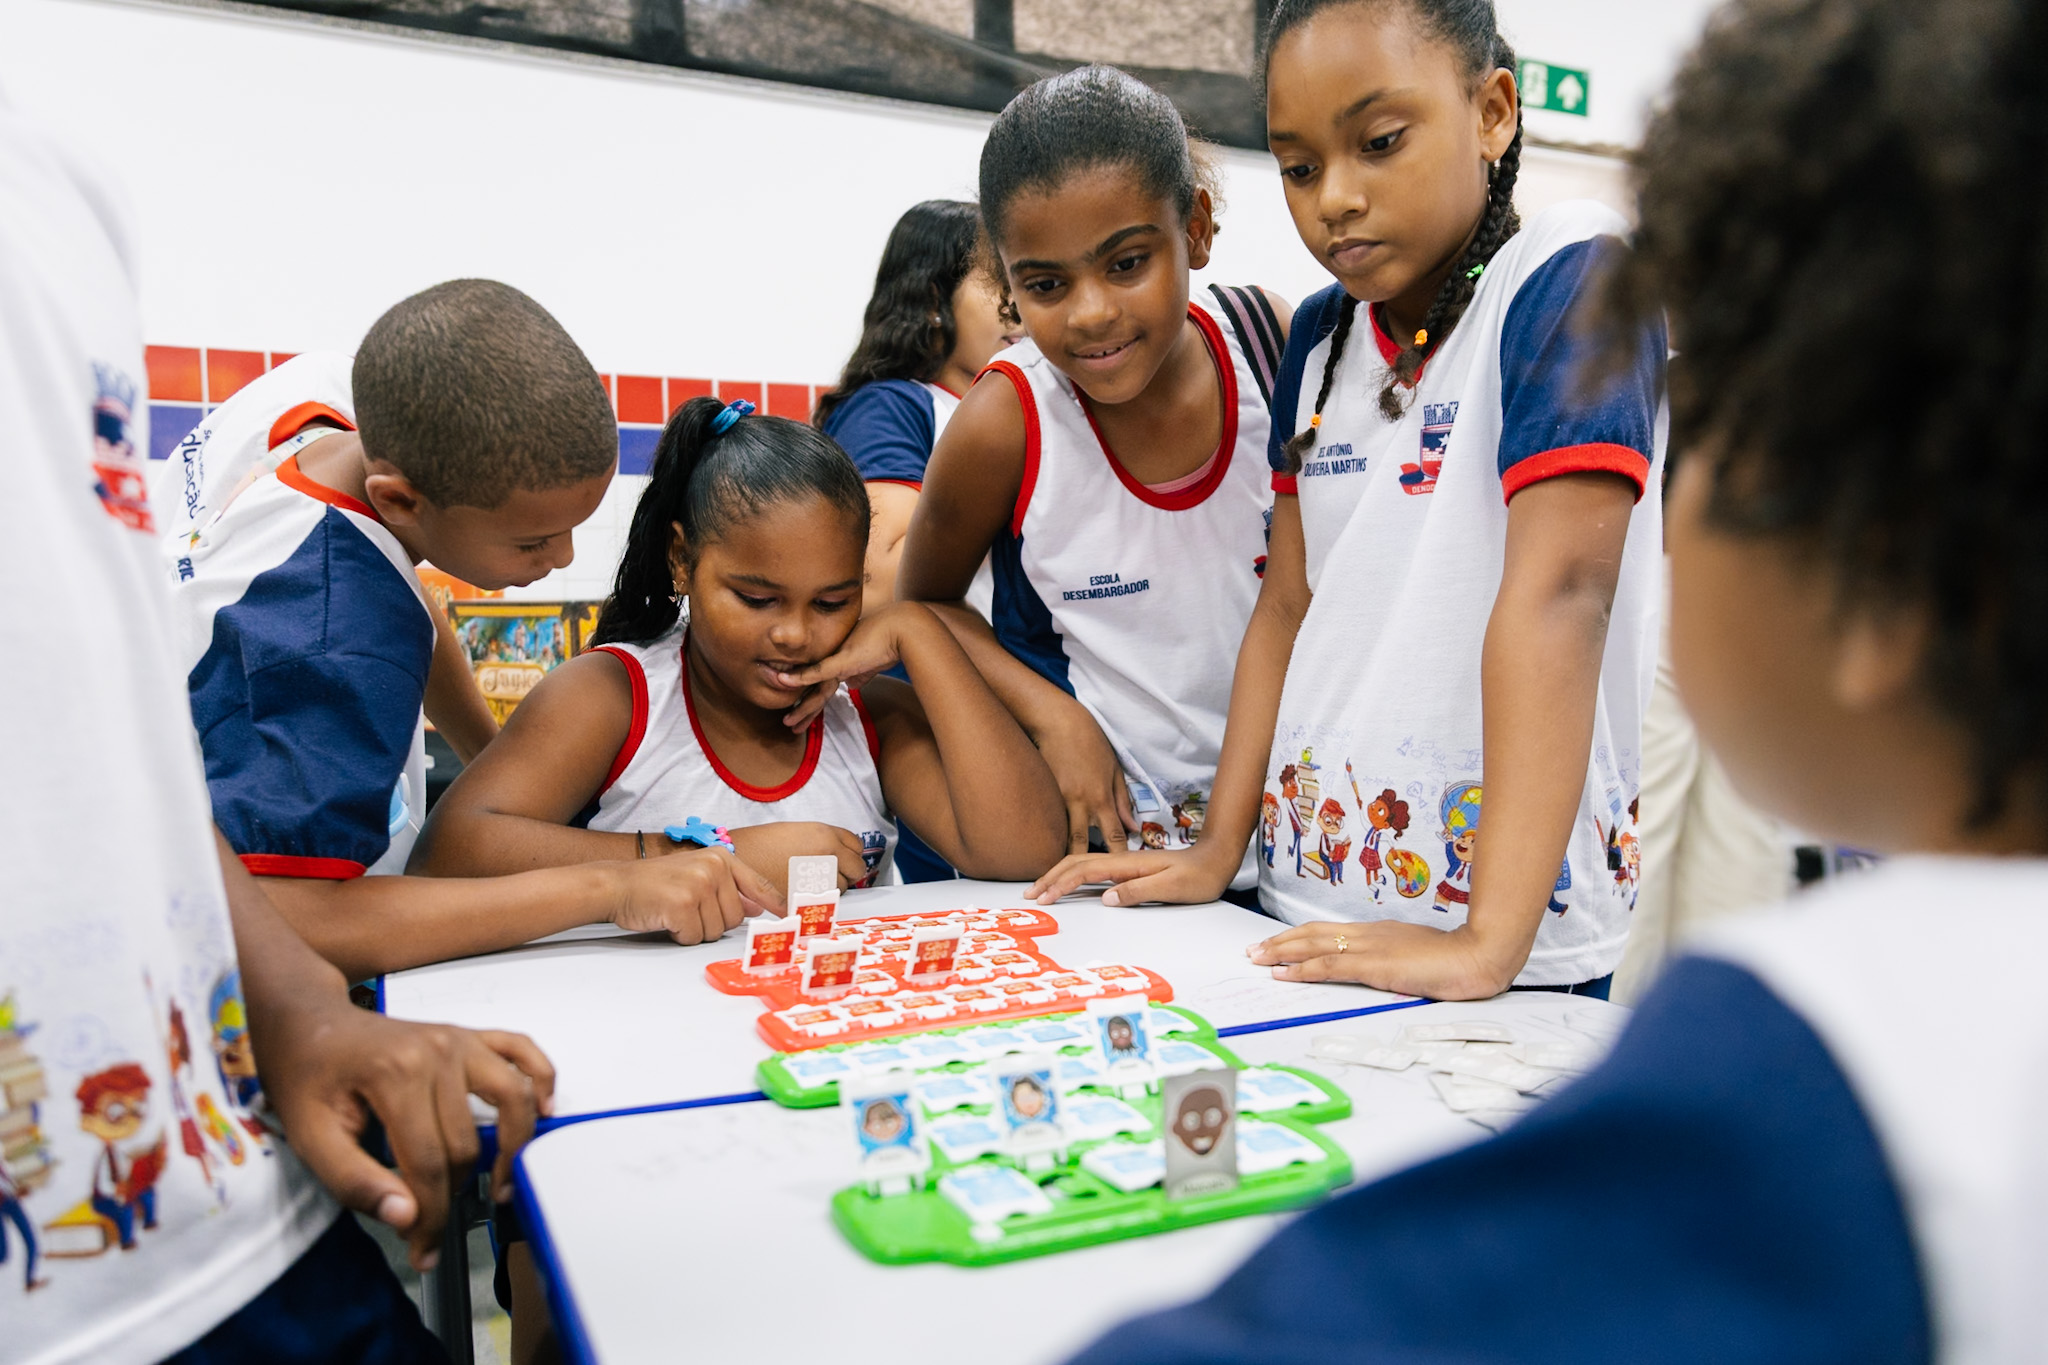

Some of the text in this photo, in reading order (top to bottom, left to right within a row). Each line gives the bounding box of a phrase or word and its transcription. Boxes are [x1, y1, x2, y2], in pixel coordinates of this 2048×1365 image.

[1326, 442, 1353, 457] ANTÔNIO
[1331, 457, 1367, 475] MARTINS
[1089, 572, 1121, 587] ESCOLA
[1062, 579, 1150, 601] DESEMBARGADOR
